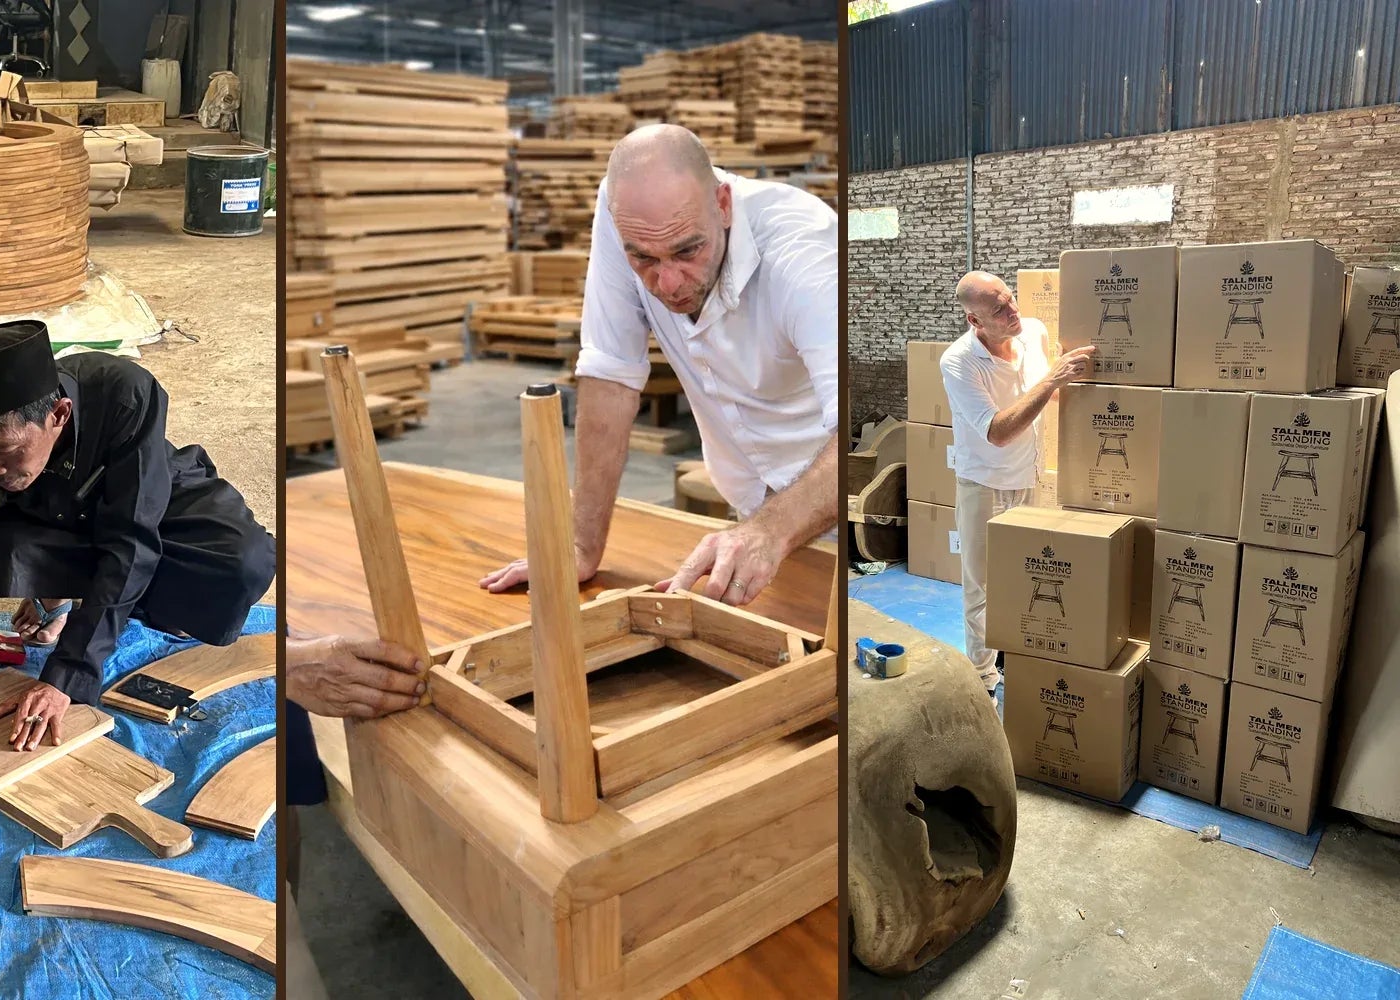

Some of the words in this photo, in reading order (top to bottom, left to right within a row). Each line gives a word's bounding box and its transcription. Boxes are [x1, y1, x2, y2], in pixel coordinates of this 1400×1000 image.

[1221, 282, 1273, 291] STANDING
[1248, 275, 1273, 283] MEN
[1094, 283, 1139, 291] STANDING
[1272, 427, 1301, 435] TALL
[1302, 429, 1331, 437] MEN
[1271, 434, 1331, 446] STANDING
[1025, 557, 1048, 565] TALL
[1049, 560, 1071, 568] MEN
[1025, 563, 1072, 575] STANDING
[1166, 557, 1190, 567] TALL
[1190, 561, 1214, 571] MEN
[1165, 563, 1214, 578] STANDING
[1261, 583, 1318, 600] STANDING
[1262, 577, 1290, 587] TALL
[1291, 582, 1318, 593] MEN
[1040, 687, 1062, 697] TALL
[1063, 692, 1085, 702] MEN
[1040, 693, 1085, 709] STANDING
[1161, 690, 1184, 701] TALL
[1185, 697, 1208, 709] MEN
[1160, 696, 1208, 715] STANDING
[1248, 721, 1301, 740] STANDING
[1249, 715, 1275, 727] TALL
[1276, 722, 1301, 733] MEN
